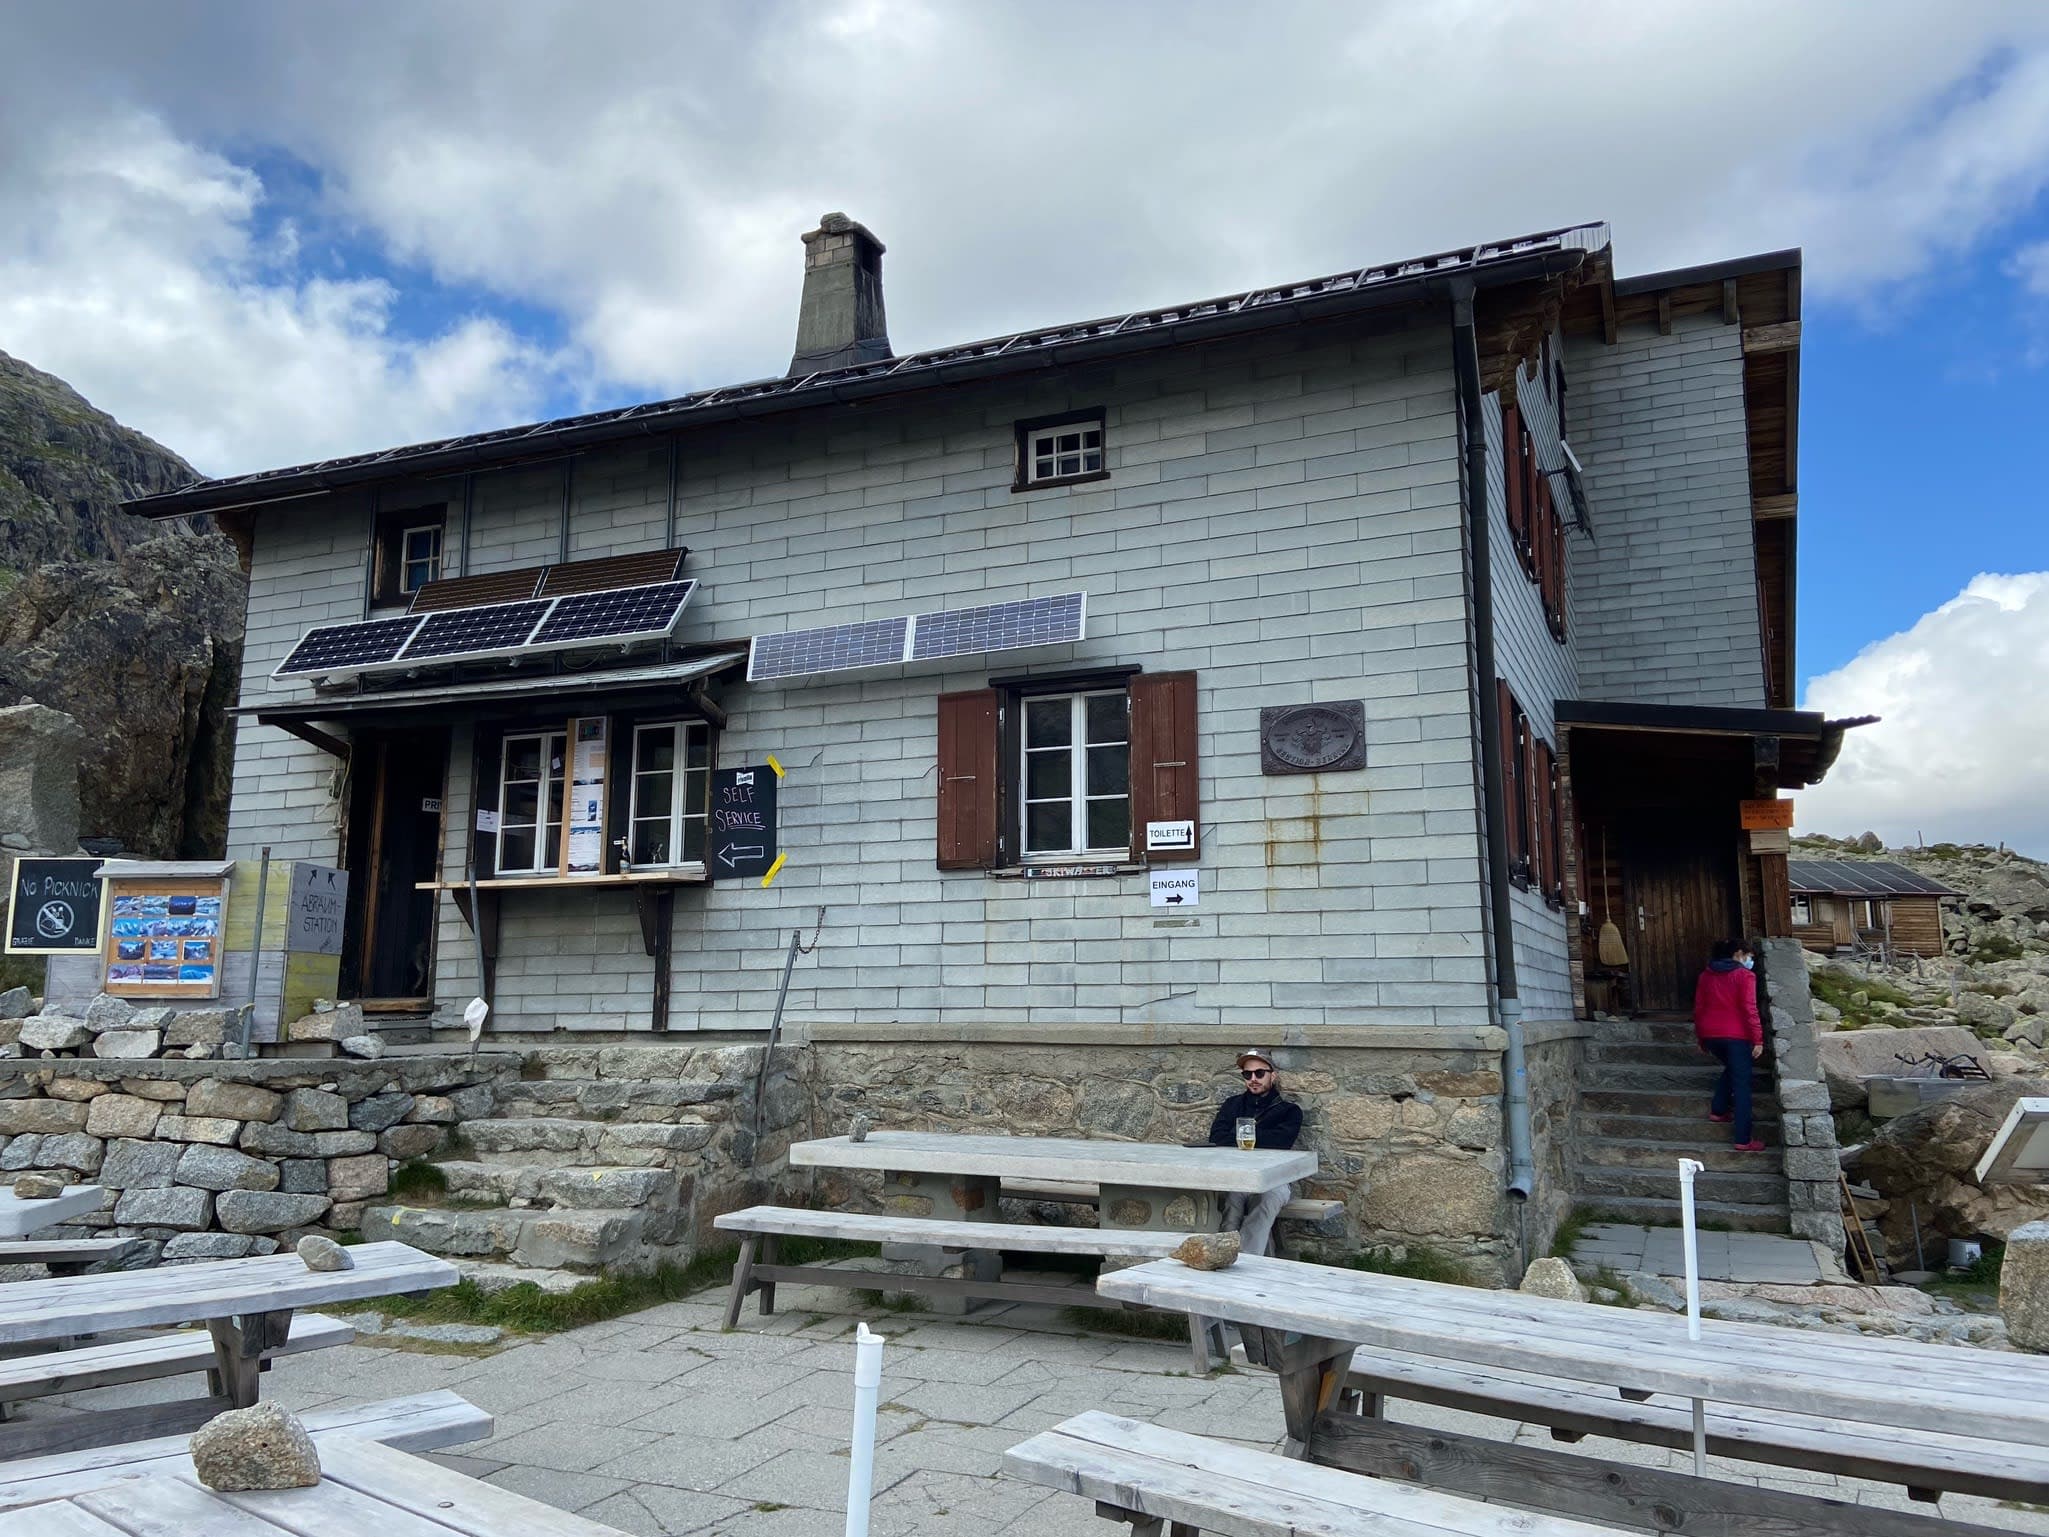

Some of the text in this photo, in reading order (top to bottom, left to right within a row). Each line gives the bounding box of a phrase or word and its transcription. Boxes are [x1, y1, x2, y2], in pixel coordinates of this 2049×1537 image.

[723, 786, 755, 804] SELF
[715, 809, 761, 832] SERVICE
[1149, 828, 1185, 838] TOILETTE
[44, 876, 99, 898] PICKNICK
[1152, 879, 1196, 890] EINGANG
[303, 916, 338, 935] STATION
[74, 937, 96, 946] DANKE
